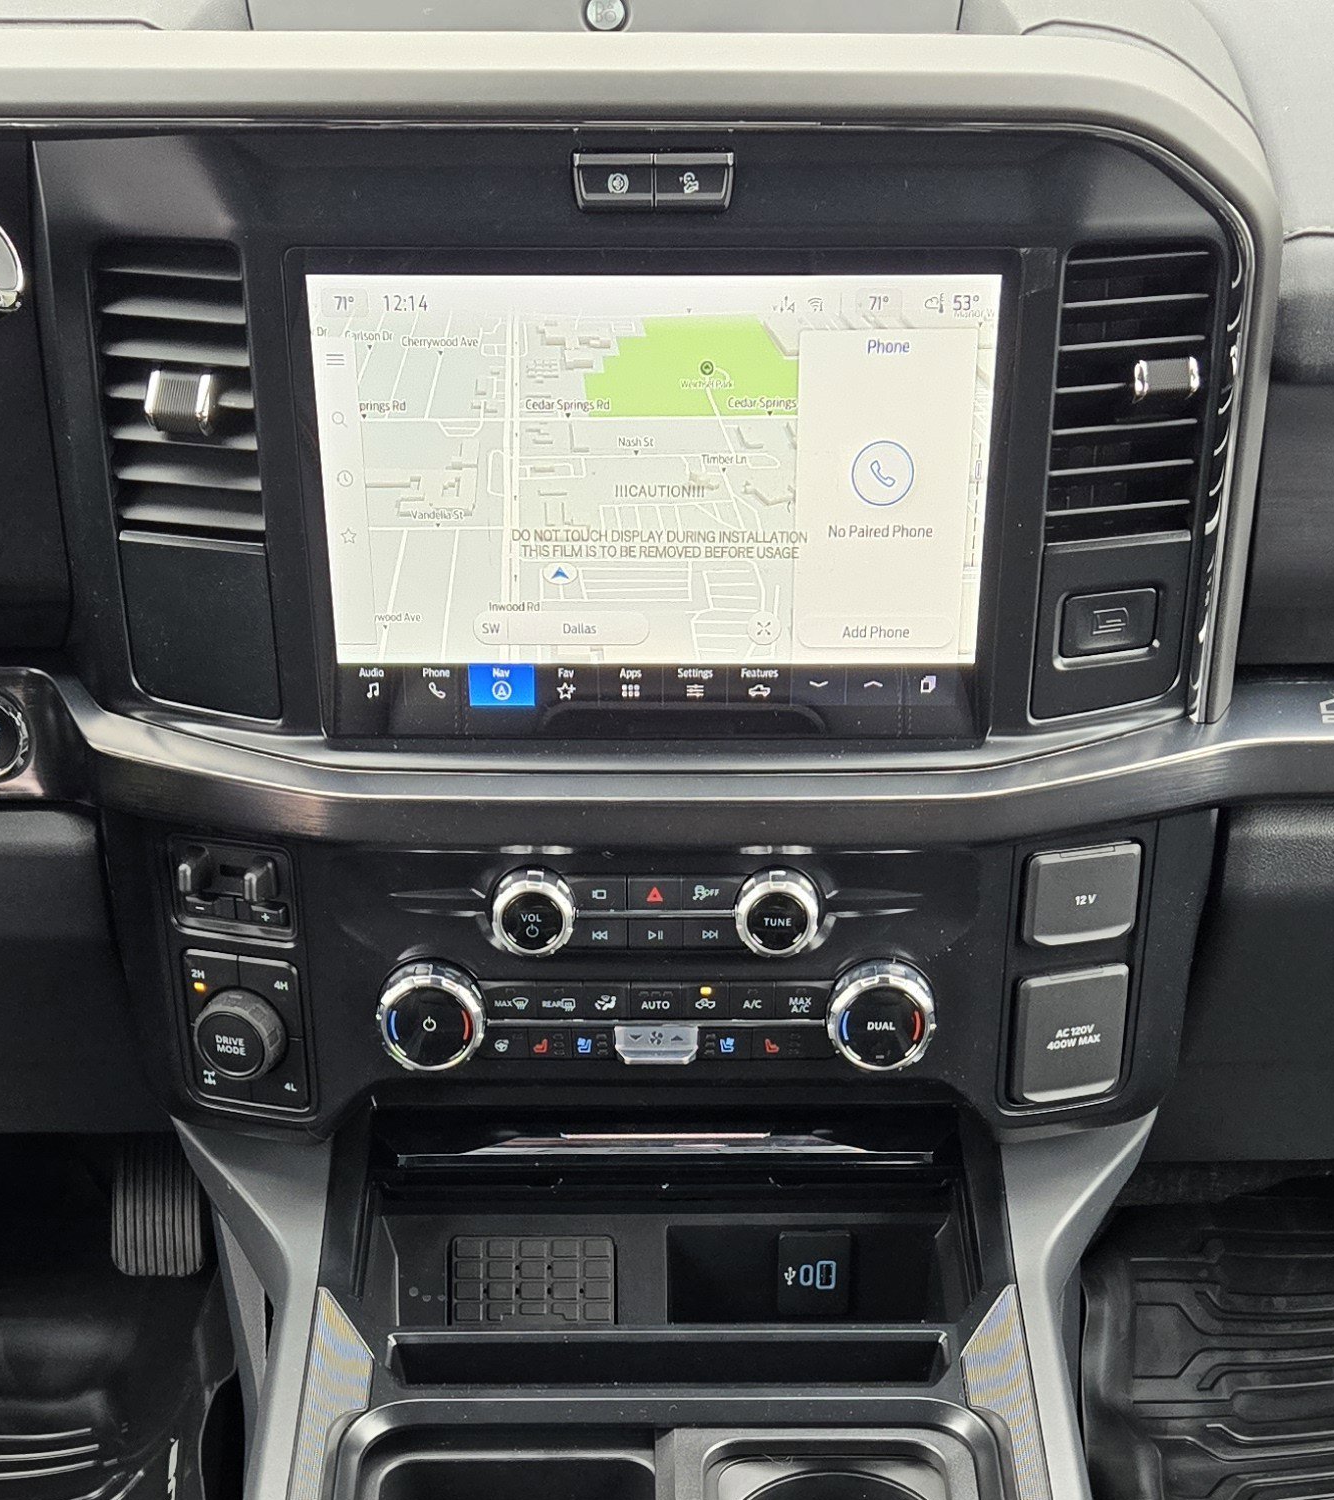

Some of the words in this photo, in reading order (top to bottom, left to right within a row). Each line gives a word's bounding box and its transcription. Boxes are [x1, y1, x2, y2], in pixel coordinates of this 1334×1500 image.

[383, 295, 428, 312] 12:14
[953, 294, 980, 311] 53°
[401, 336, 453, 349] Cherrywood
[454, 336, 479, 348] Ave
[867, 338, 910, 354] Phone
[392, 400, 406, 411] Rd
[525, 399, 555, 411] Cedar
[557, 399, 595, 413] Springs
[596, 399, 611, 411] Rd
[728, 397, 757, 408] Cedar
[759, 396, 797, 410] Springs
[618, 436, 642, 448] Nash
[643, 436, 655, 448] St
[701, 453, 729, 465] Timber
[730, 454, 748, 465] Ln
[453, 509, 465, 521] St
[511, 529, 531, 541] DO
[534, 529, 560, 542] NOT
[564, 529, 608, 542] TOUCH
[611, 530, 663, 543] DISPLAY
[667, 531, 715, 543] DURING
[719, 531, 808, 544] INSTALLATION
[828, 525, 847, 539] No
[848, 525, 890, 539] Paired
[891, 525, 933, 539] Phone
[522, 545, 549, 557] THIS
[552, 545, 583, 558] FILM
[586, 545, 598, 558] IS
[600, 545, 617, 558] TO
[620, 545, 636, 558] BE
[639, 546, 701, 559] REMOVED
[705, 546, 754, 559] BEFORE
[756, 547, 800, 560] USAGE
[489, 602, 523, 612] Inwood
[525, 602, 540, 612] Rd
[404, 612, 421, 622] Ave
[481, 623, 500, 635] SW
[563, 623, 597, 635] Dallas
[842, 626, 867, 639] Add
[870, 626, 910, 639] Phone
[359, 667, 385, 679] Audio
[422, 667, 451, 679] Phone
[492, 667, 510, 679] Nav
[557, 667, 575, 680] Fav
[620, 667, 642, 680] Apps
[677, 667, 714, 680] Settings
[740, 667, 779, 679] Features
[1074, 893, 1098, 906] 12V
[520, 913, 543, 923] VOL
[763, 917, 793, 927] TUNE
[191, 968, 205, 980] 2H
[273, 980, 289, 991] 4H
[494, 1000, 513, 1008] MAX
[641, 1000, 670, 1010] AUTO
[742, 1000, 762, 1009] A/C
[788, 997, 812, 1006] MAX
[791, 1005, 810, 1014] A/C
[867, 1021, 896, 1031] DUAL
[1055, 1027, 1070, 1038] AC
[1070, 1024, 1095, 1037] 120V
[215, 1034, 245, 1047] DRIVE
[1047, 1037, 1076, 1051] 400W
[1078, 1033, 1101, 1046] MAX
[217, 1044, 247, 1057] MODE
[283, 1082, 298, 1093] 4L
